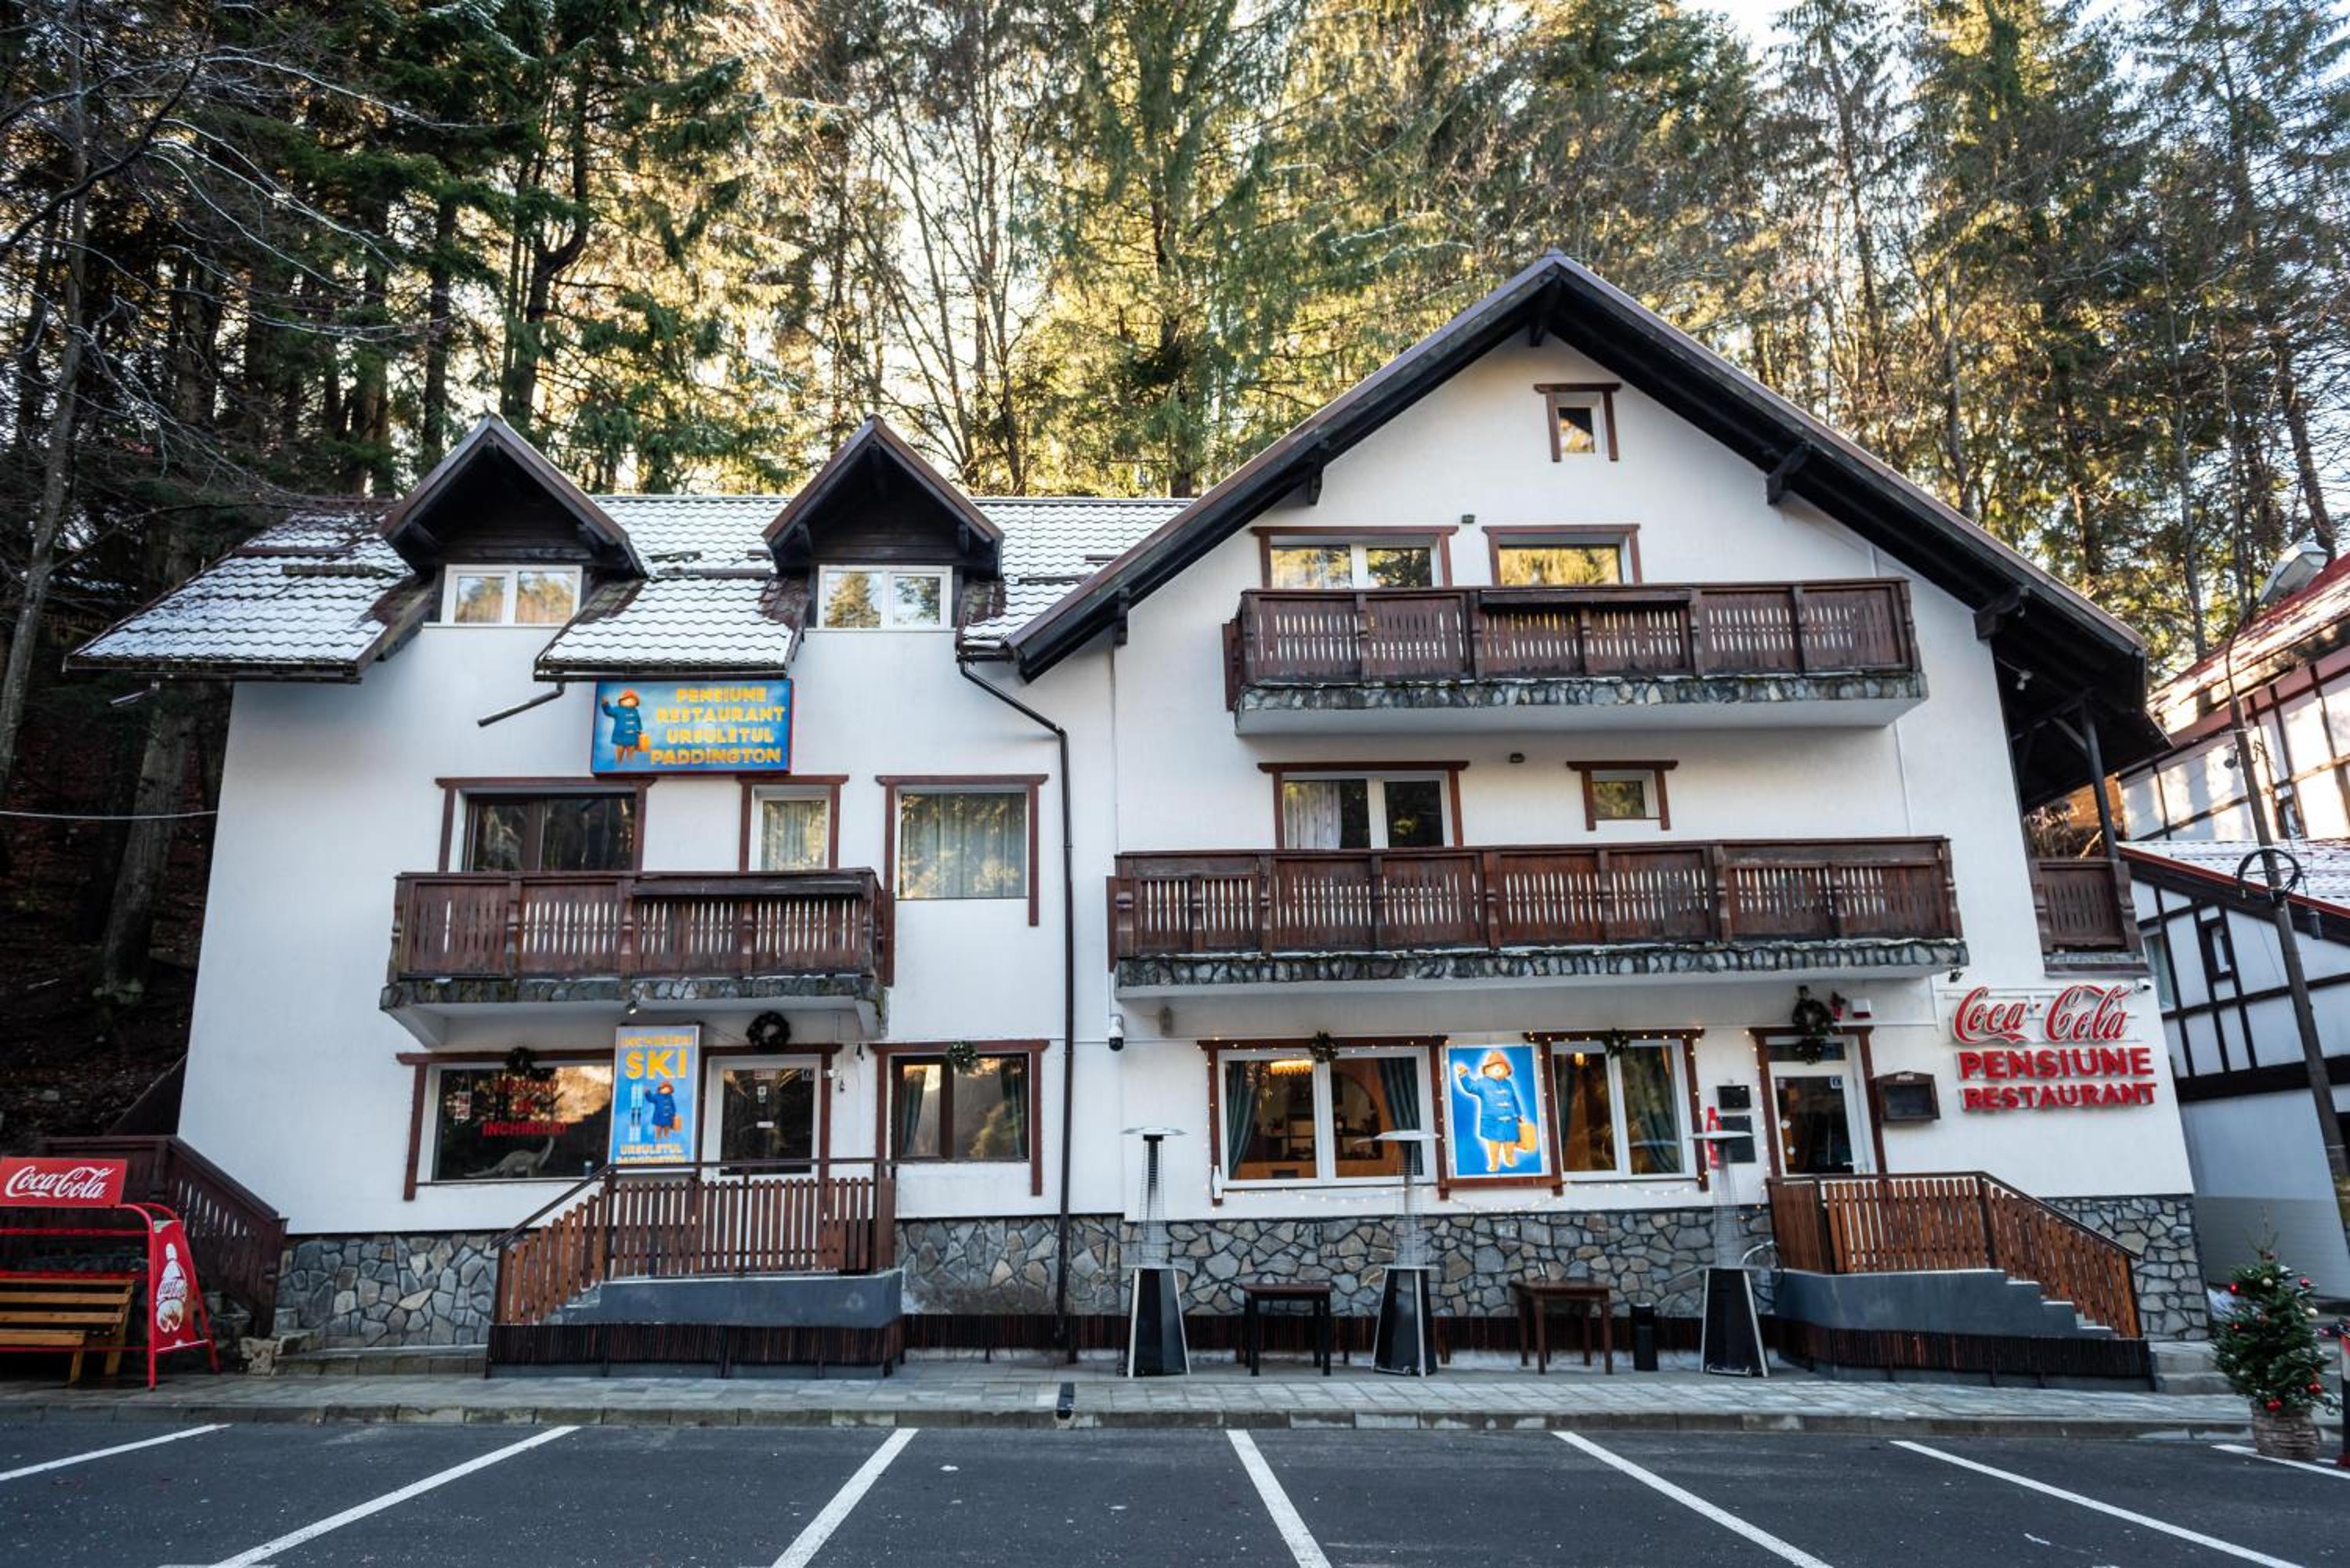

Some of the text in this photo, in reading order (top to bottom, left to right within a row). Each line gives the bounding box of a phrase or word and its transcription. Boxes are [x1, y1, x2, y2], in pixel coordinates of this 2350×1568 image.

[676, 687, 767, 703] PENSIUNE
[656, 706, 785, 722] RESTAURANT
[667, 727, 775, 743] URSULETUL
[650, 748, 782, 764] PADDINGTON
[626, 1050, 687, 1078] SKI
[1958, 1047, 2154, 1079] PENSIUNE
[1963, 1082, 2157, 1112] RESTAURANT
[5, 1165, 116, 1198] Coca-Cola
